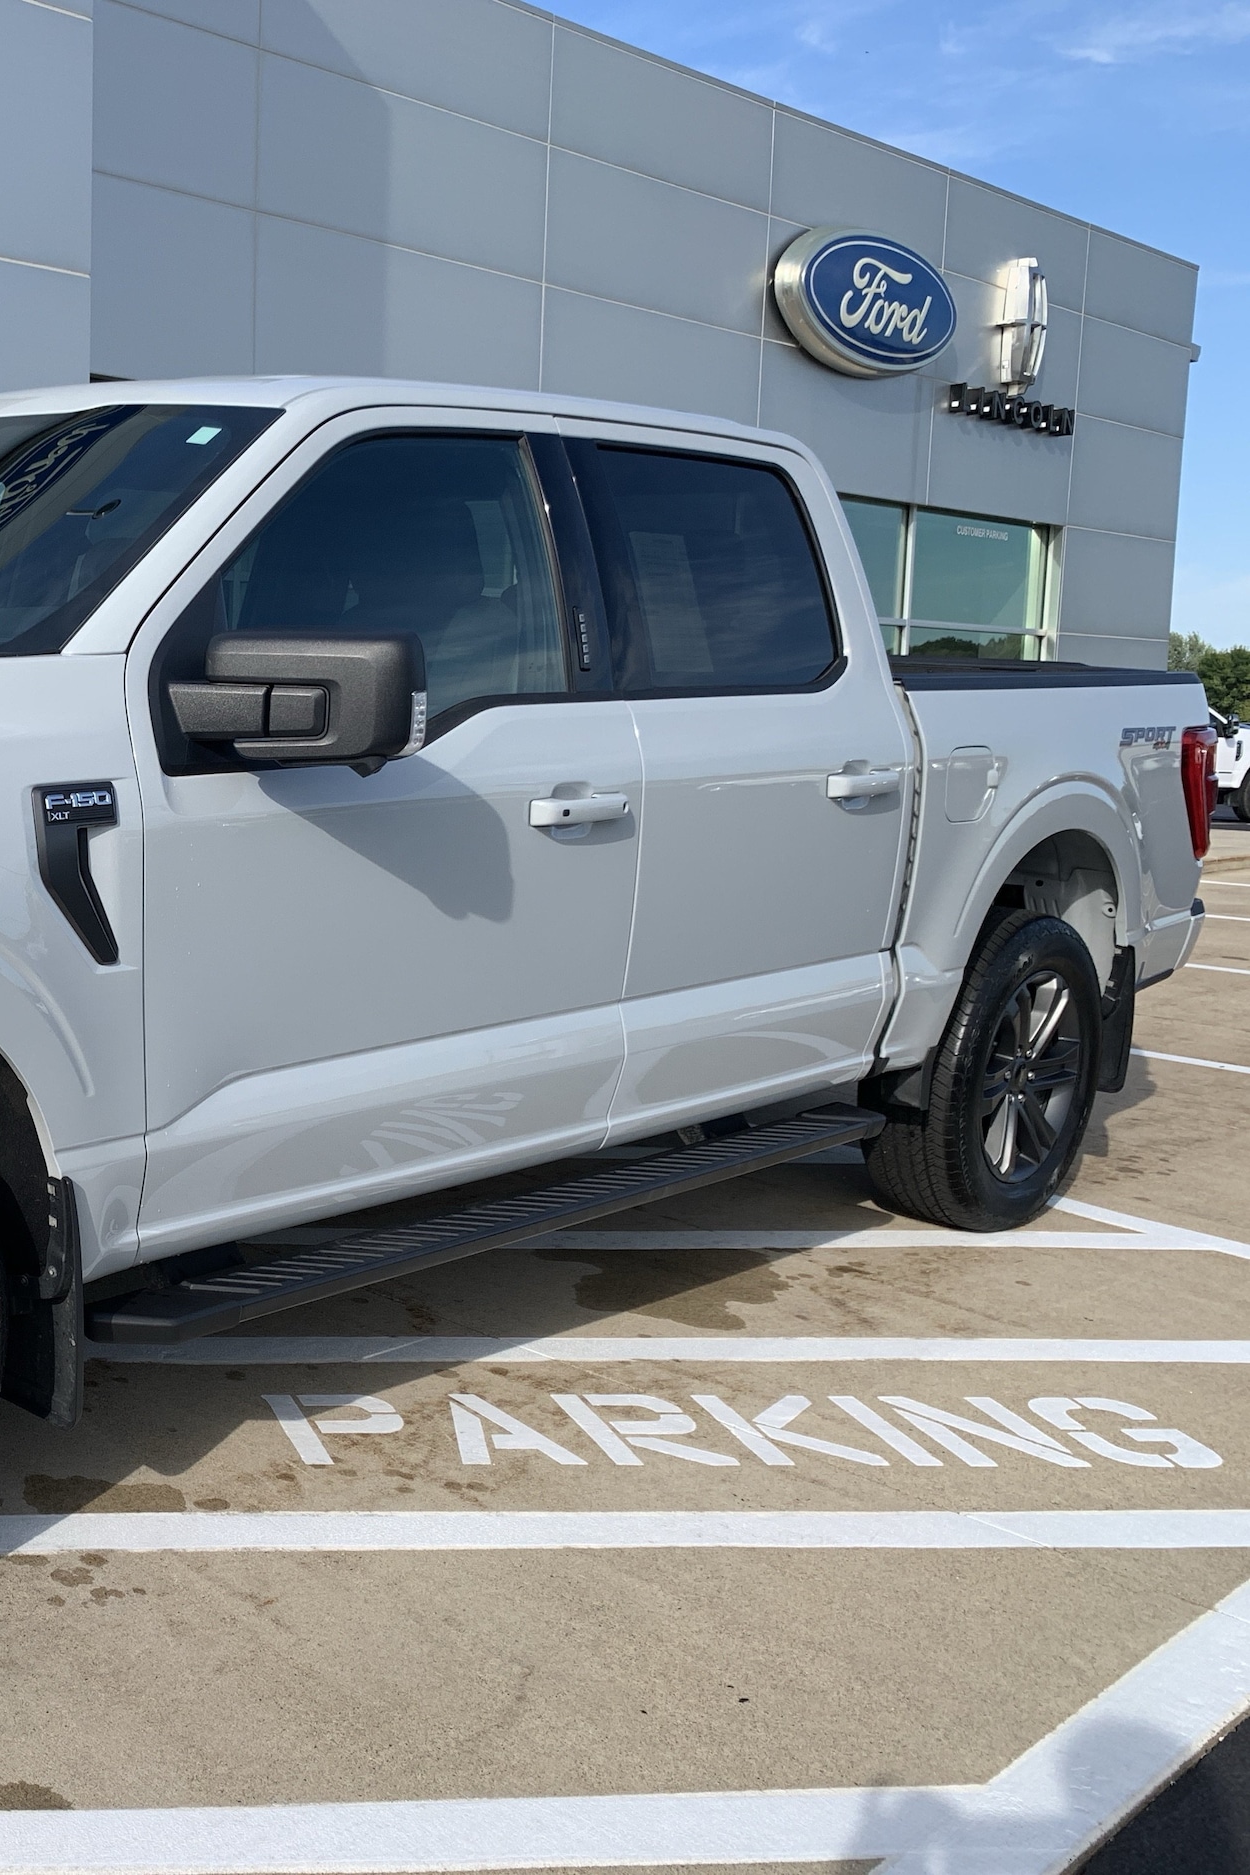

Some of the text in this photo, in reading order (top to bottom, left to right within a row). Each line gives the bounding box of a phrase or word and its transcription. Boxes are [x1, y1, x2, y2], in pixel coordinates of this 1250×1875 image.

[840, 257, 933, 345] Ford
[950, 382, 1075, 436] LINCOLN
[956, 525, 1009, 541] CUSTOMER PARKING
[1119, 726, 1177, 747] SPORT
[44, 790, 112, 810] F-150
[51, 811, 70, 821] XLT
[262, 1392, 1225, 1469] PARKING
